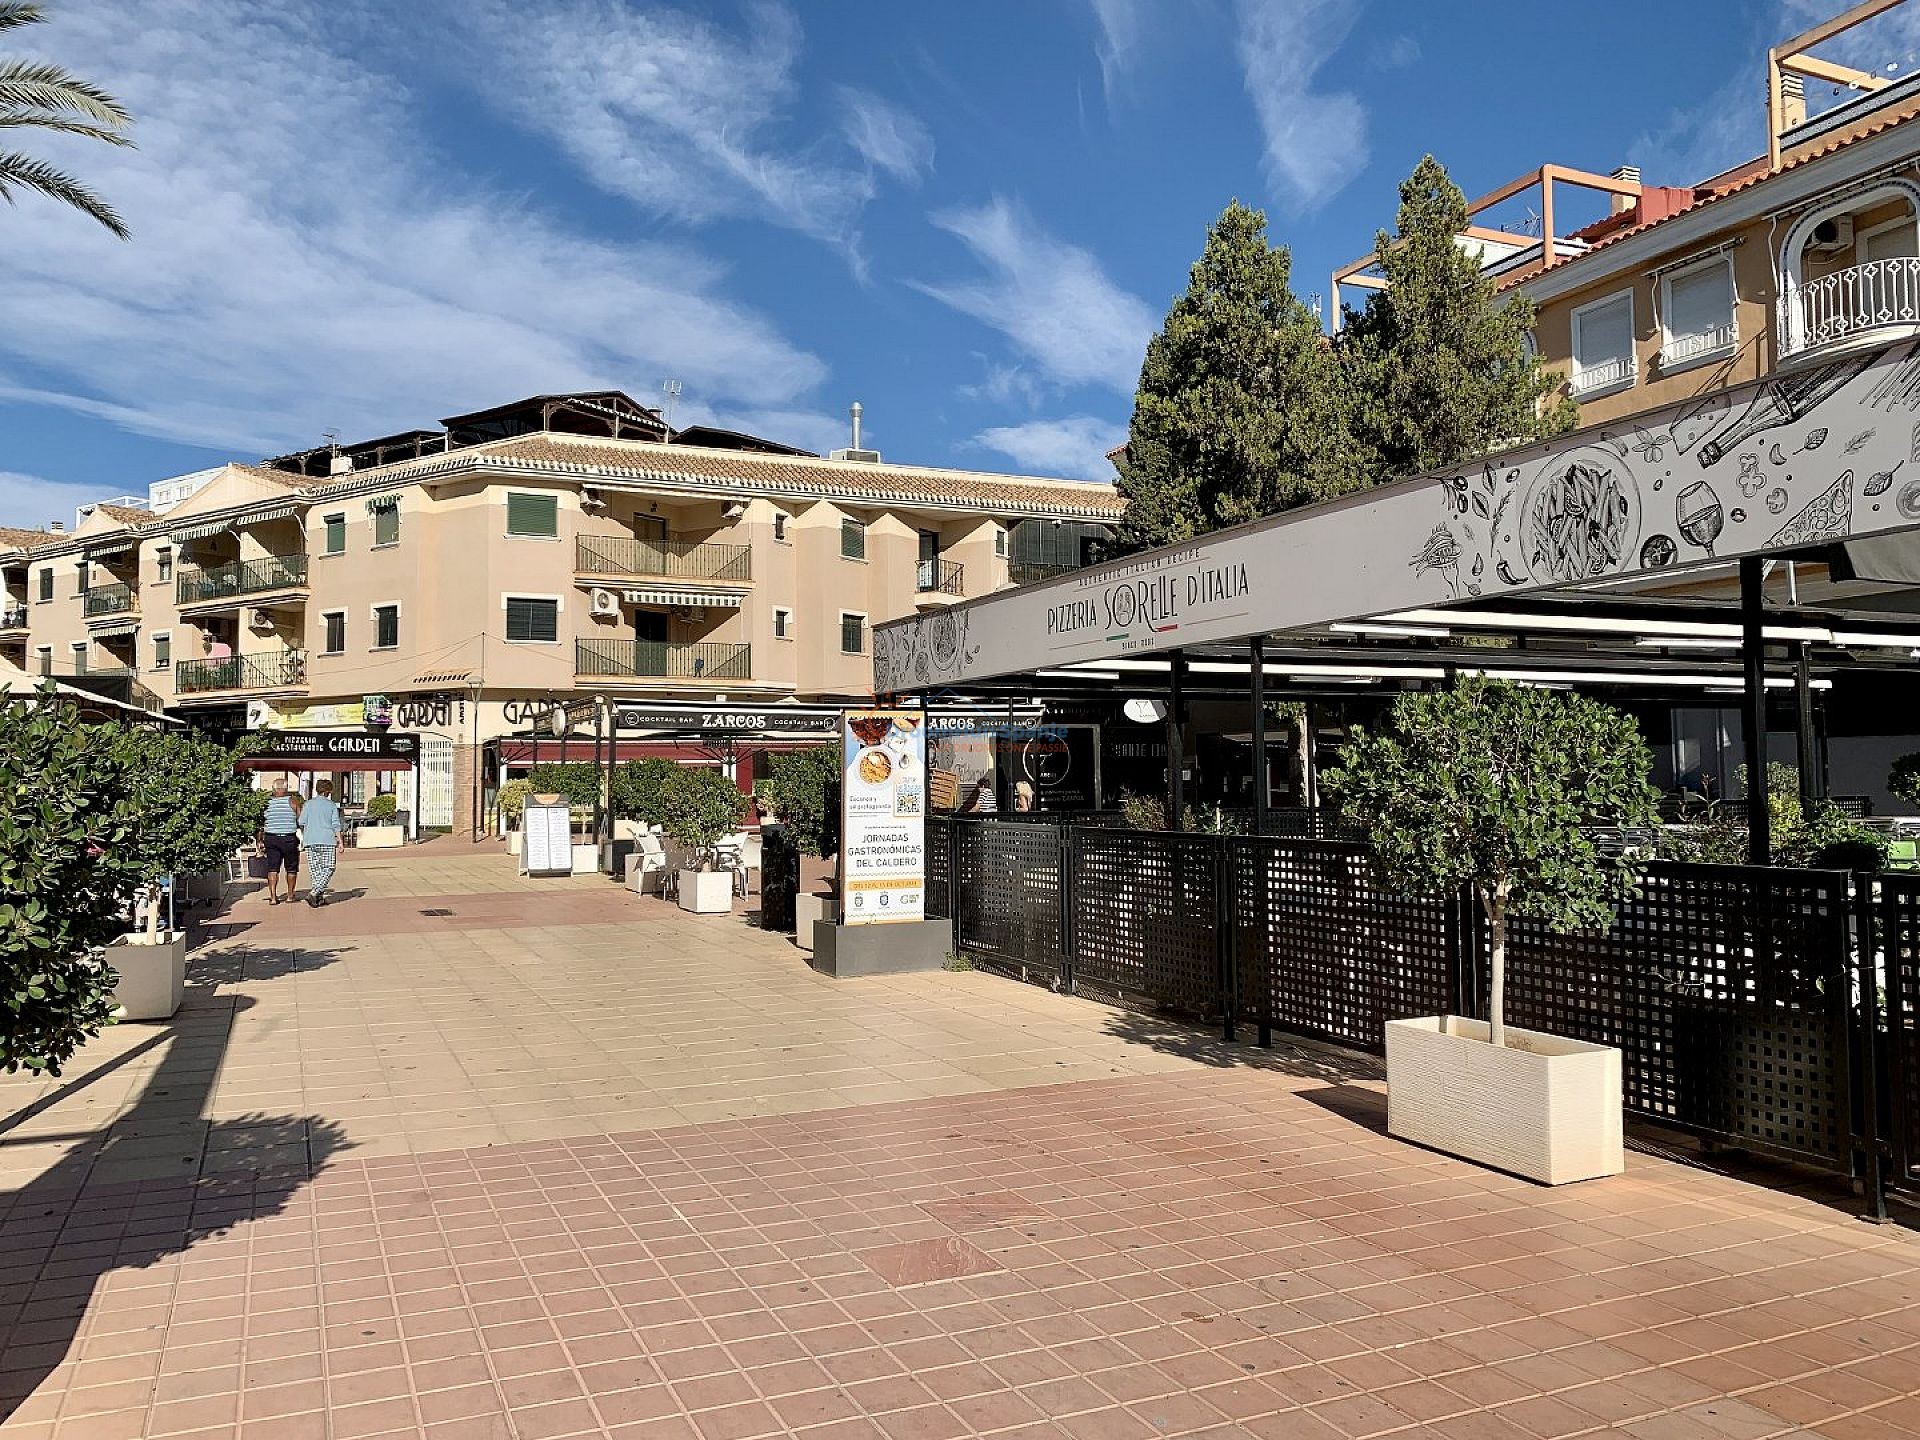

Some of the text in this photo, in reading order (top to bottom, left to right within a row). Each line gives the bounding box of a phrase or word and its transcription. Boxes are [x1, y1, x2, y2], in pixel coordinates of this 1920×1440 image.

[1047, 562, 1249, 634] PIZZERIA SORELLE D'ITALIA
[398, 701, 453, 728] GARDEN
[702, 714, 766, 729] ZARCOS
[928, 718, 976, 730] ARCOS
[329, 737, 380, 753] GARDEN
[862, 833, 909, 843] JORNADAS
[847, 844, 922, 857] GASTRONÓMICAS
[856, 857, 917, 868] DEL CALDERO
